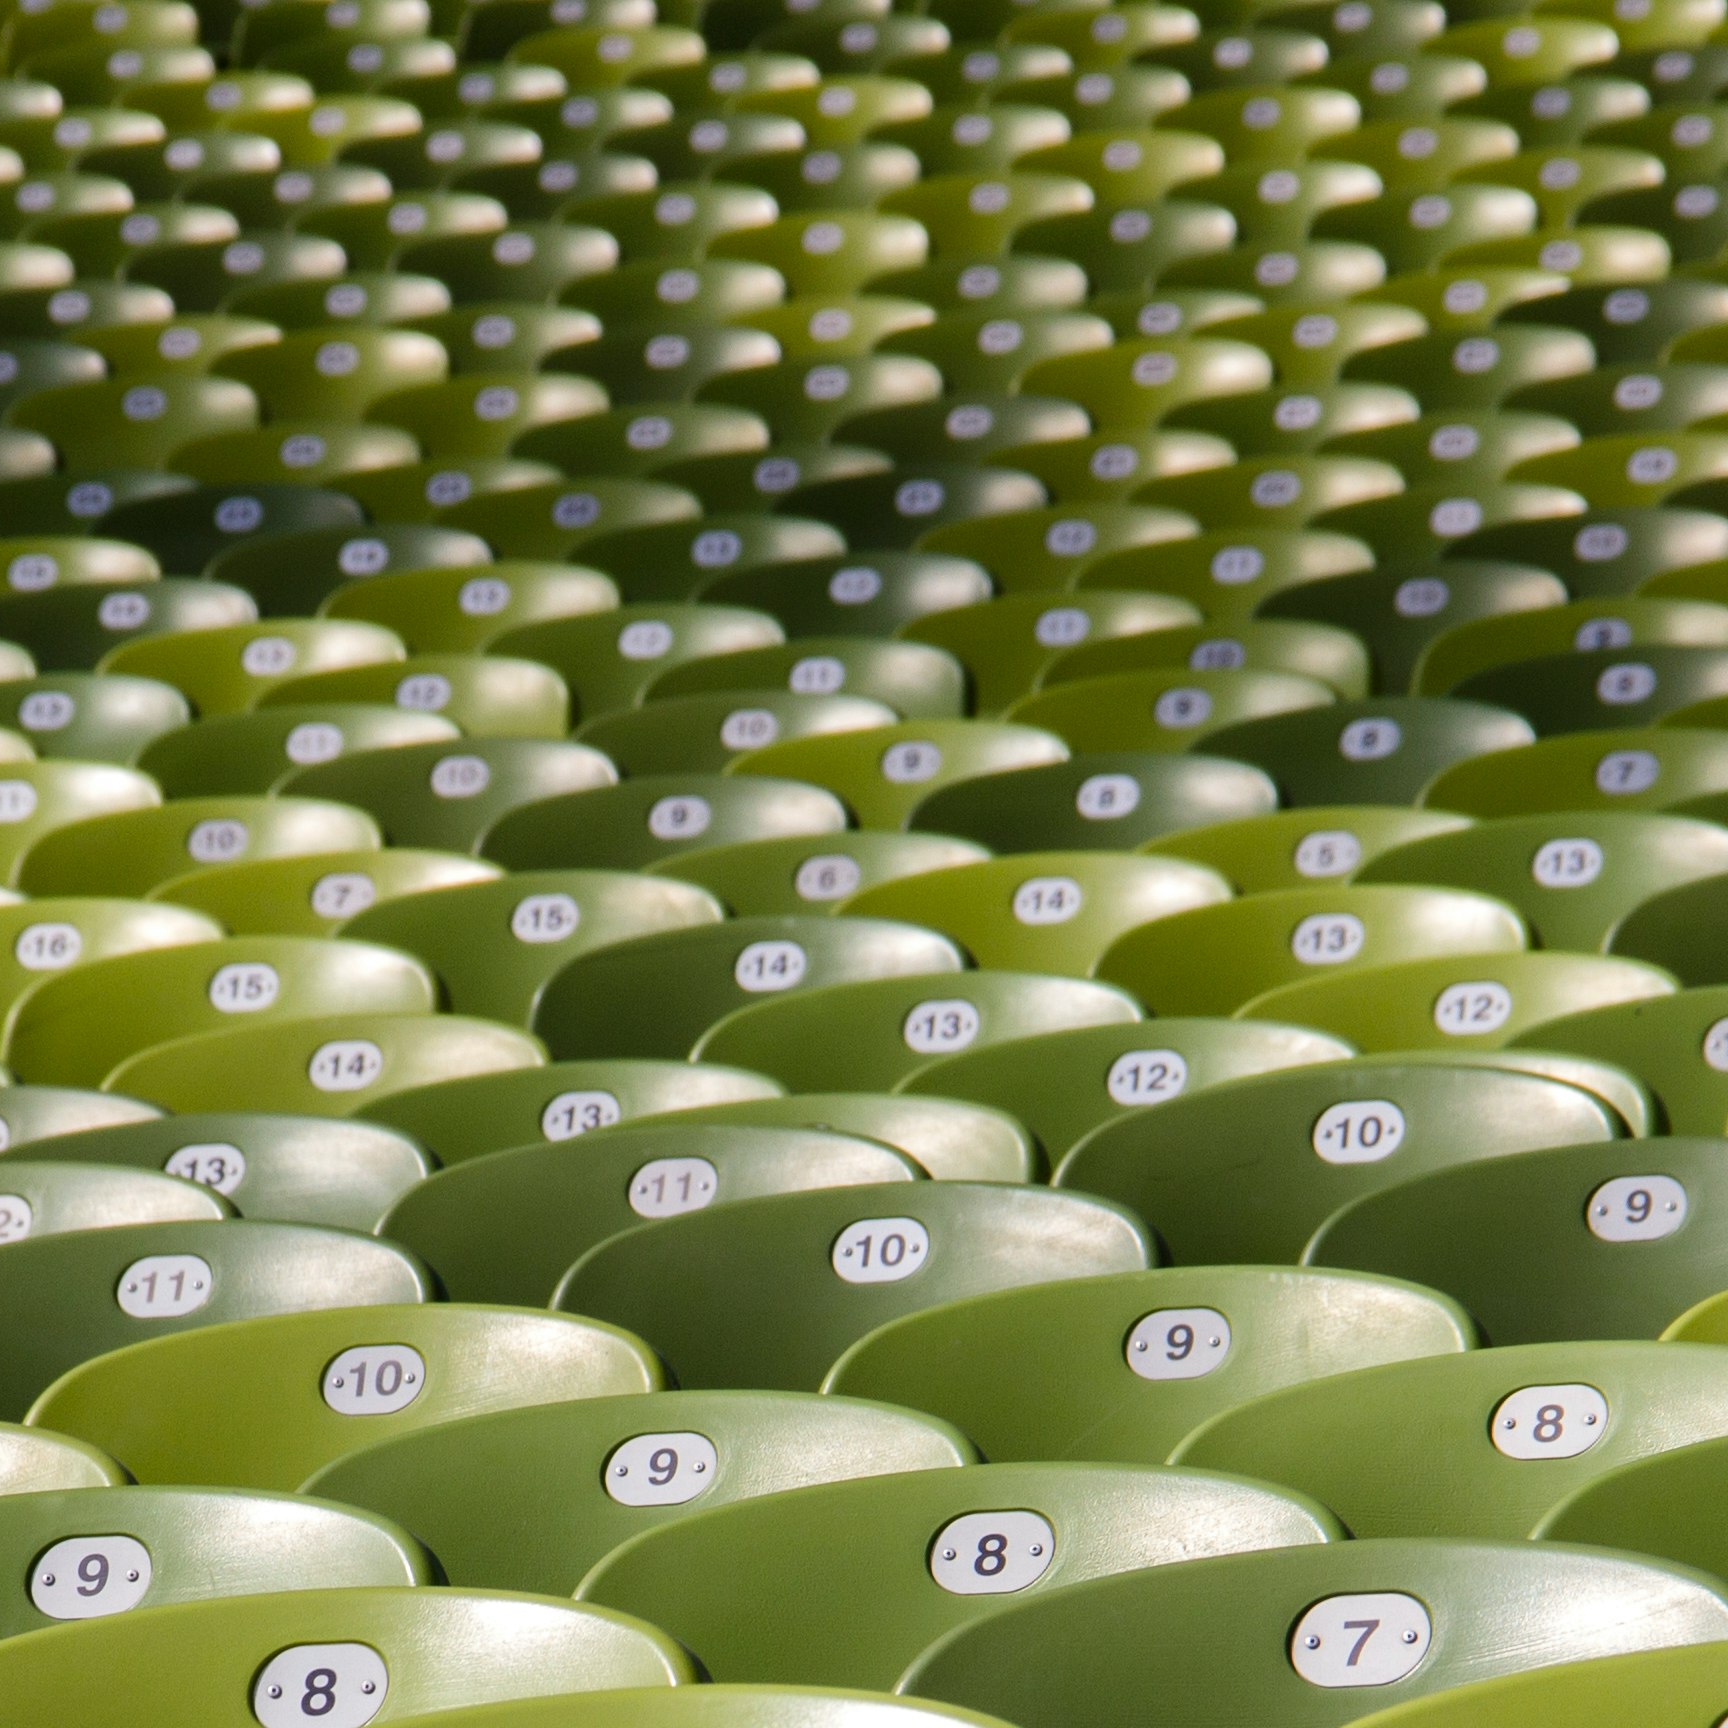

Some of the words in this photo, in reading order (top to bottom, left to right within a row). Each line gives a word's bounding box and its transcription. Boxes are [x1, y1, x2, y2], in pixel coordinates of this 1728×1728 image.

[1552, 849, 1587, 875] 13
[1032, 889, 1065, 911] 14
[531, 905, 565, 929] 15
[1311, 925, 1347, 953] 13
[755, 953, 788, 978] 14
[229, 974, 264, 999] 15
[1455, 994, 1494, 1022] 12
[924, 1013, 961, 1040] 13
[331, 1052, 365, 1078] 14
[1128, 1063, 1169, 1093] 12
[561, 1104, 601, 1132] 13
[1335, 1115, 1383, 1150] 10
[182, 1157, 224, 1187] 13
[651, 1171, 692, 1204] 11
[1625, 1189, 1653, 1225] 9
[855, 1233, 906, 1269] 10
[141, 1270, 186, 1304] 11
[1165, 1323, 1195, 1362] 9
[349, 1359, 404, 1398] 10
[1532, 1403, 1565, 1444] 8
[647, 1447, 679, 1487] 9
[973, 1533, 1009, 1577] 8
[76, 1553, 110, 1598] 9
[1342, 1618, 1381, 1667] 7
[300, 1667, 338, 1717] 8
